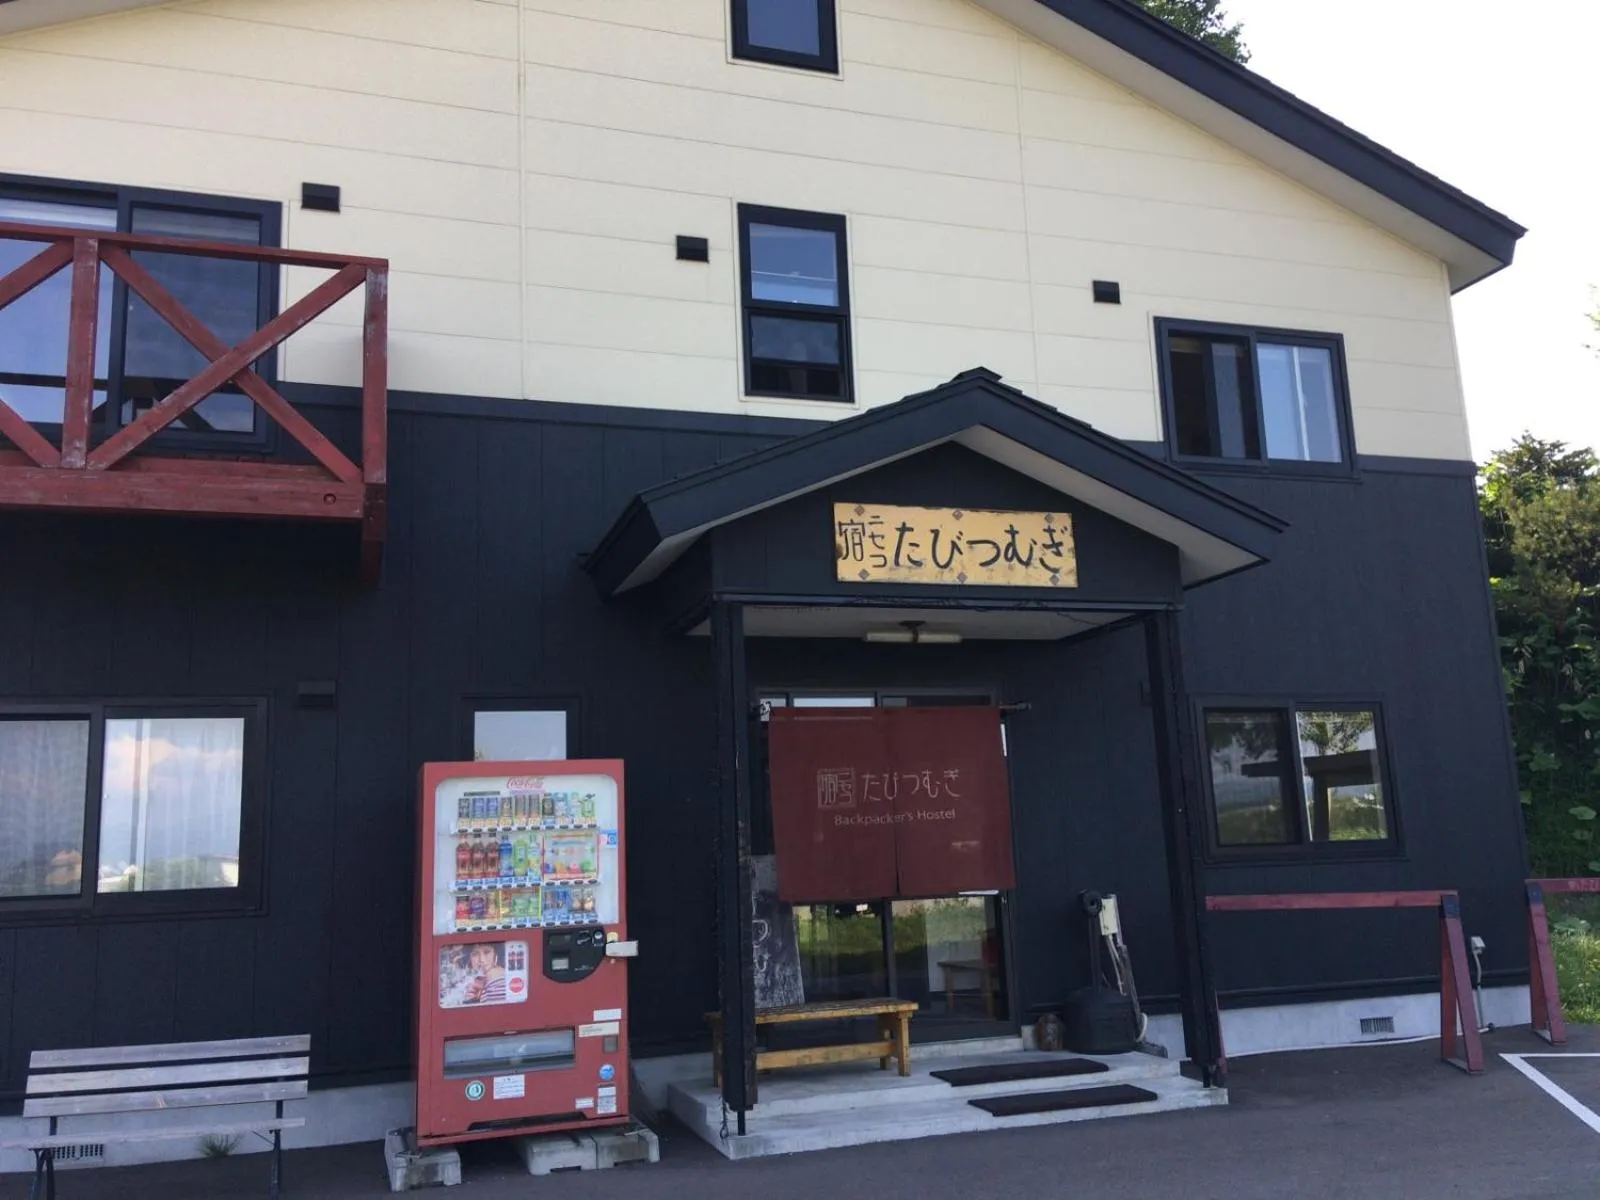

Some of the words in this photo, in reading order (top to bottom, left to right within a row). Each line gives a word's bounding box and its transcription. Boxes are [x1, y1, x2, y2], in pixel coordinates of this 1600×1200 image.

[868, 515, 888, 568] ニセコ
[894, 521, 1068, 574] たびつむぎ
[861, 768, 960, 802] たびつむぎ
[834, 811, 914, 826] Backpacker's
[917, 807, 956, 821] Hostel
